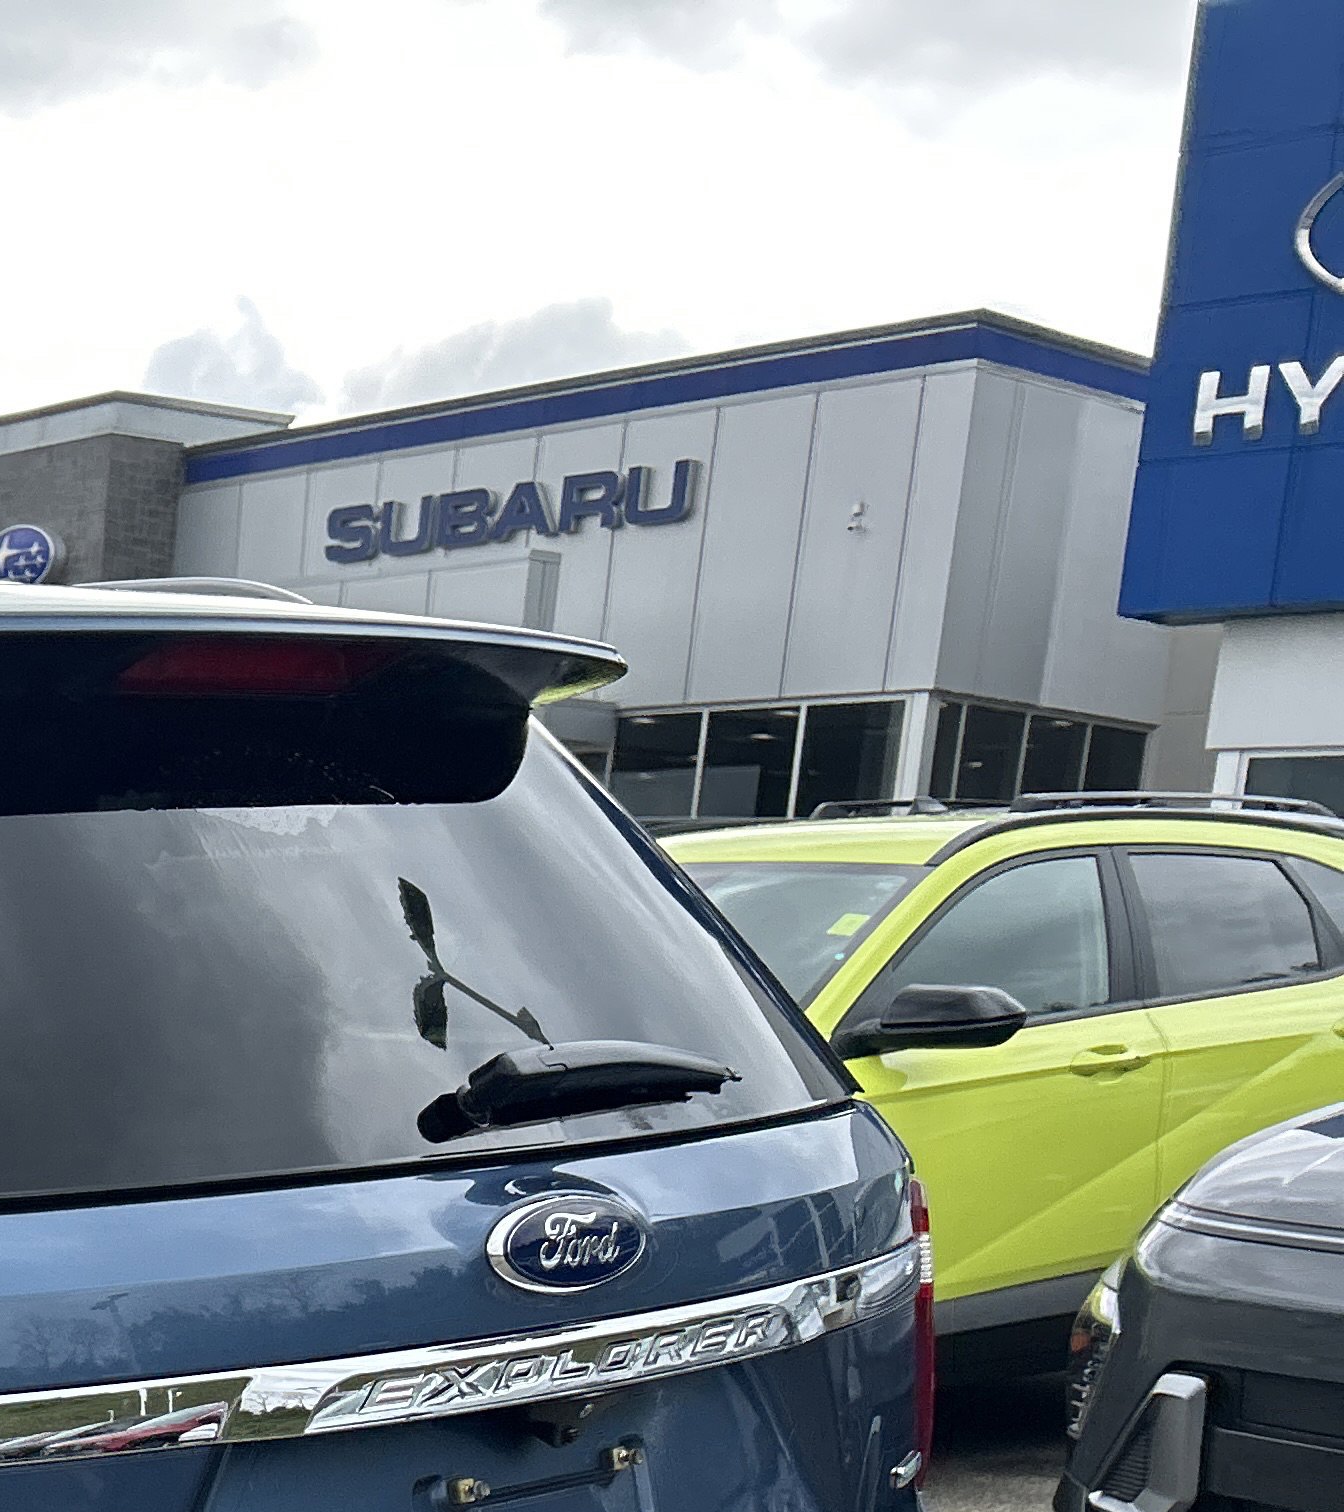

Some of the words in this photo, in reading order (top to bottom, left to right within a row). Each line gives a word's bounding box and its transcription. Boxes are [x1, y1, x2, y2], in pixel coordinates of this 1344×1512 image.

[325, 459, 699, 563] SUBARU
[540, 1211, 621, 1270] Ford
[357, 1309, 778, 1414] EXPLORER
